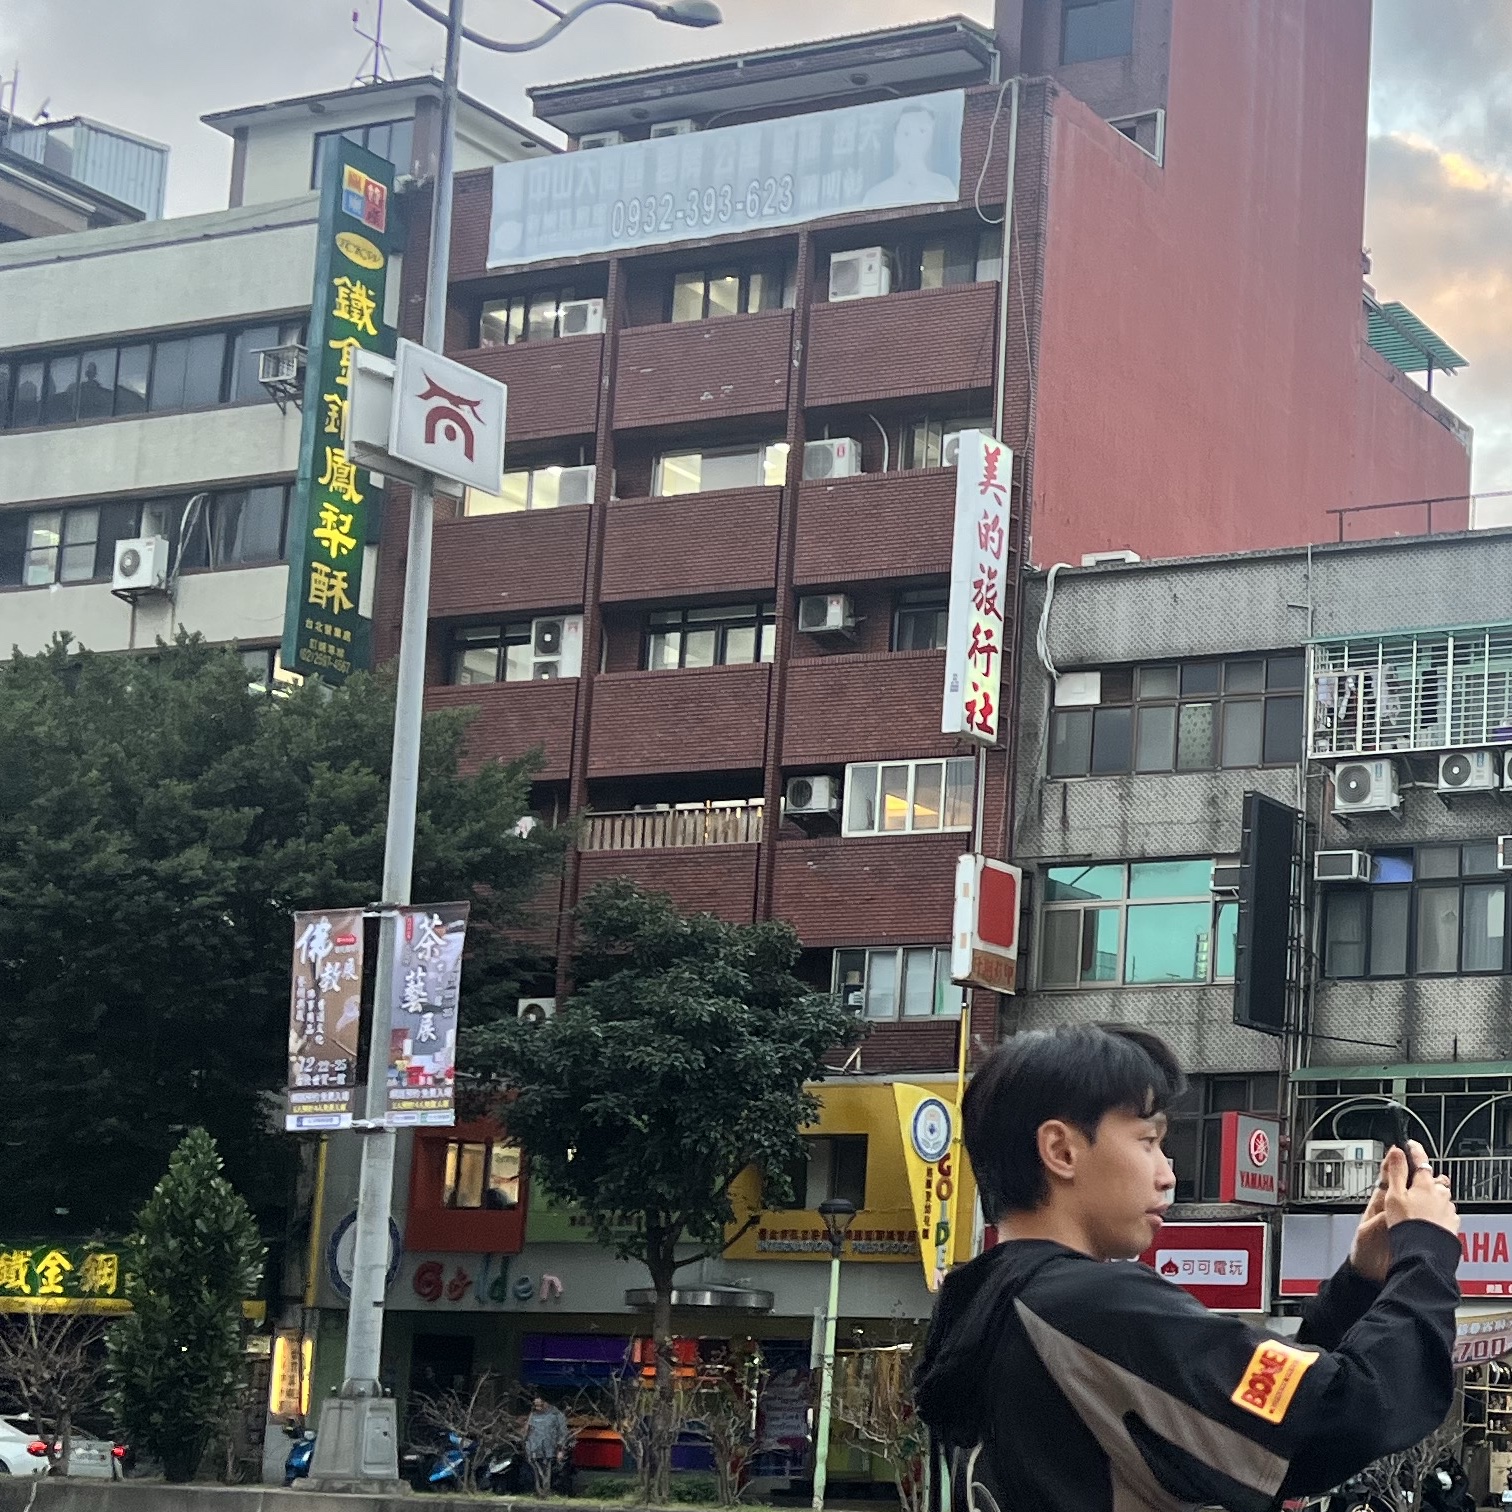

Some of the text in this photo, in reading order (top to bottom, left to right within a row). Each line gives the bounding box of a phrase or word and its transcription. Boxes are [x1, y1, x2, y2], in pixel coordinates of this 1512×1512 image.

[611, 174, 794, 239] 0932-393-623
[965, 443, 1008, 735] 美的旅行社
[1240, 1171, 1274, 1192] YAMAHA
[1182, 1259, 1243, 1275] 可可電玩
